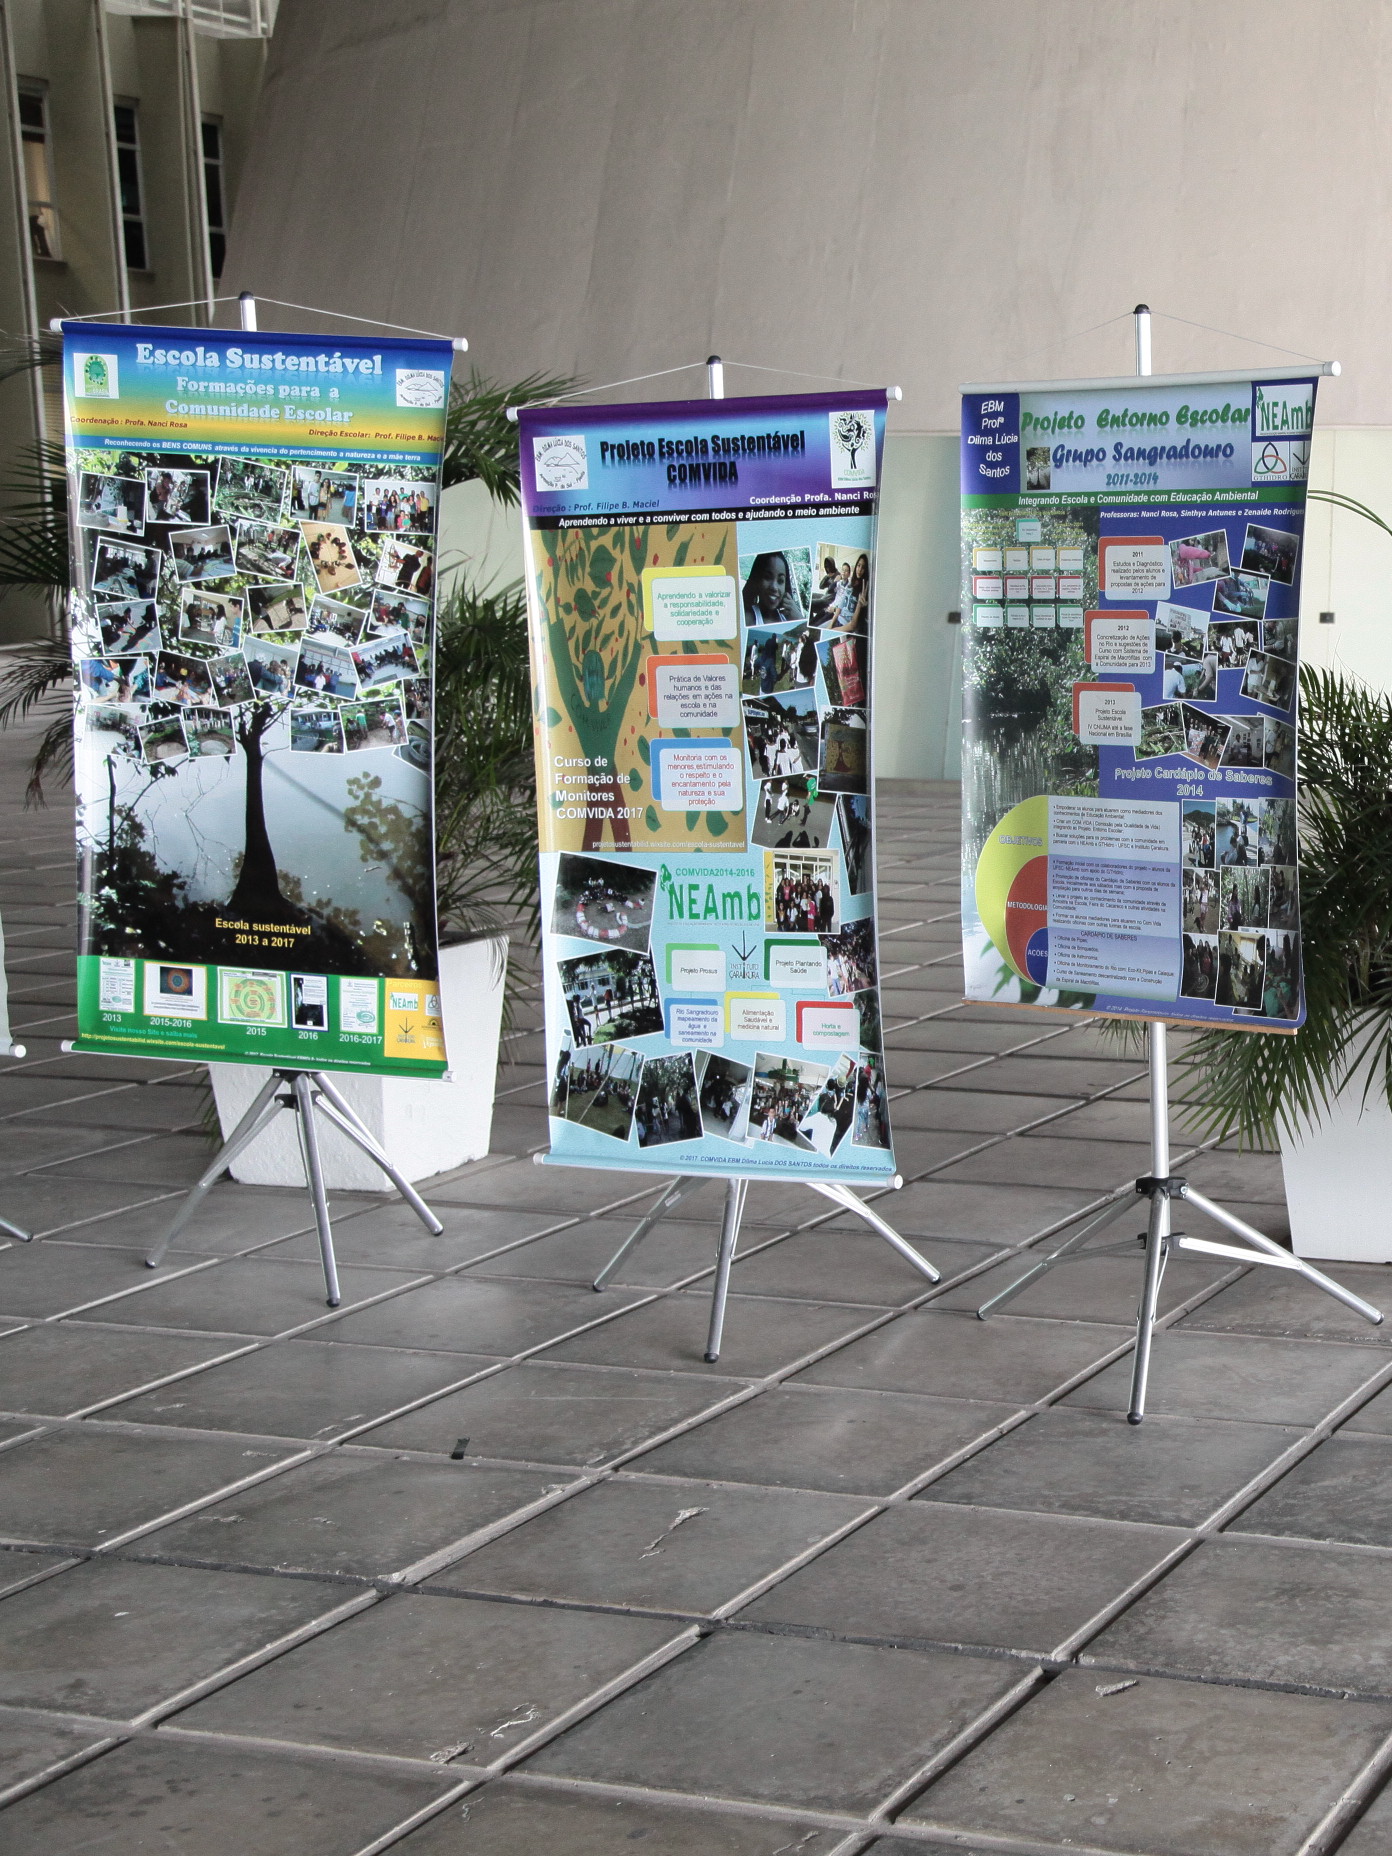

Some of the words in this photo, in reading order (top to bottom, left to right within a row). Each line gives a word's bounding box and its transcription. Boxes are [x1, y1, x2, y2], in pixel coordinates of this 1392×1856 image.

[135, 343, 221, 368] Escola
[225, 348, 383, 375] Sustentável
[176, 376, 275, 396] Formações
[278, 385, 320, 398] para
[165, 399, 280, 419] Comunidade
[284, 405, 354, 423] Escolar
[980, 400, 1004, 414] EBM
[1020, 412, 1085, 433] Projeto
[1096, 410, 1170, 430] Entorno
[1175, 405, 1252, 428] Escolar
[600, 440, 655, 461] Projeto
[658, 439, 707, 458] Escola
[711, 430, 806, 456] Sustentável
[967, 434, 993, 445] Dilma
[995, 432, 1019, 444] Lúcia
[985, 450, 1002, 461] dos
[1051, 446, 1106, 467] Grupo
[1111, 442, 1234, 464] Sangradouro
[666, 461, 738, 483] COMVIDA
[978, 464, 1010, 478] Santos
[1105, 472, 1159, 486] 2011-2014
[1018, 495, 1060, 507] Integrando
[1061, 494, 1088, 504] Escola
[1096, 493, 1148, 503] Comunidade
[1149, 494, 1168, 502] com
[1170, 491, 1212, 503] Educação
[1213, 490, 1258, 500] Ambiental
[558, 515, 608, 530] Aprendendo
[616, 514, 637, 525] viver
[652, 511, 689, 524] conviver
[691, 513, 710, 522] com
[711, 509, 736, 521] todos
[745, 507, 785, 522] ajudando
[794, 506, 817, 518] meio
[818, 504, 860, 517] ambiente
[554, 756, 591, 767] Curso
[594, 756, 608, 767] de
[555, 772, 614, 787] Formação
[616, 772, 631, 784] de
[1114, 766, 1152, 781] Projeto
[1154, 767, 1205, 782] Cardápio
[1207, 769, 1222, 781] de
[1224, 770, 1272, 785] Saberes
[555, 789, 615, 802] Monitores
[1176, 783, 1203, 796] 2014
[556, 807, 616, 819] COMVIDA
[617, 807, 644, 819] 2017
[667, 883, 761, 921] NEAmb
[215, 917, 249, 930] Escola
[252, 922, 311, 935] sustentável
[235, 933, 259, 945] 2013
[271, 936, 294, 948] 2017
[102, 1012, 121, 1022] 2013
[149, 1016, 192, 1028] 2015-2016
[246, 1026, 266, 1036] 2015
[298, 1030, 318, 1040] 2016
[339, 1033, 382, 1044] 2016-2017
